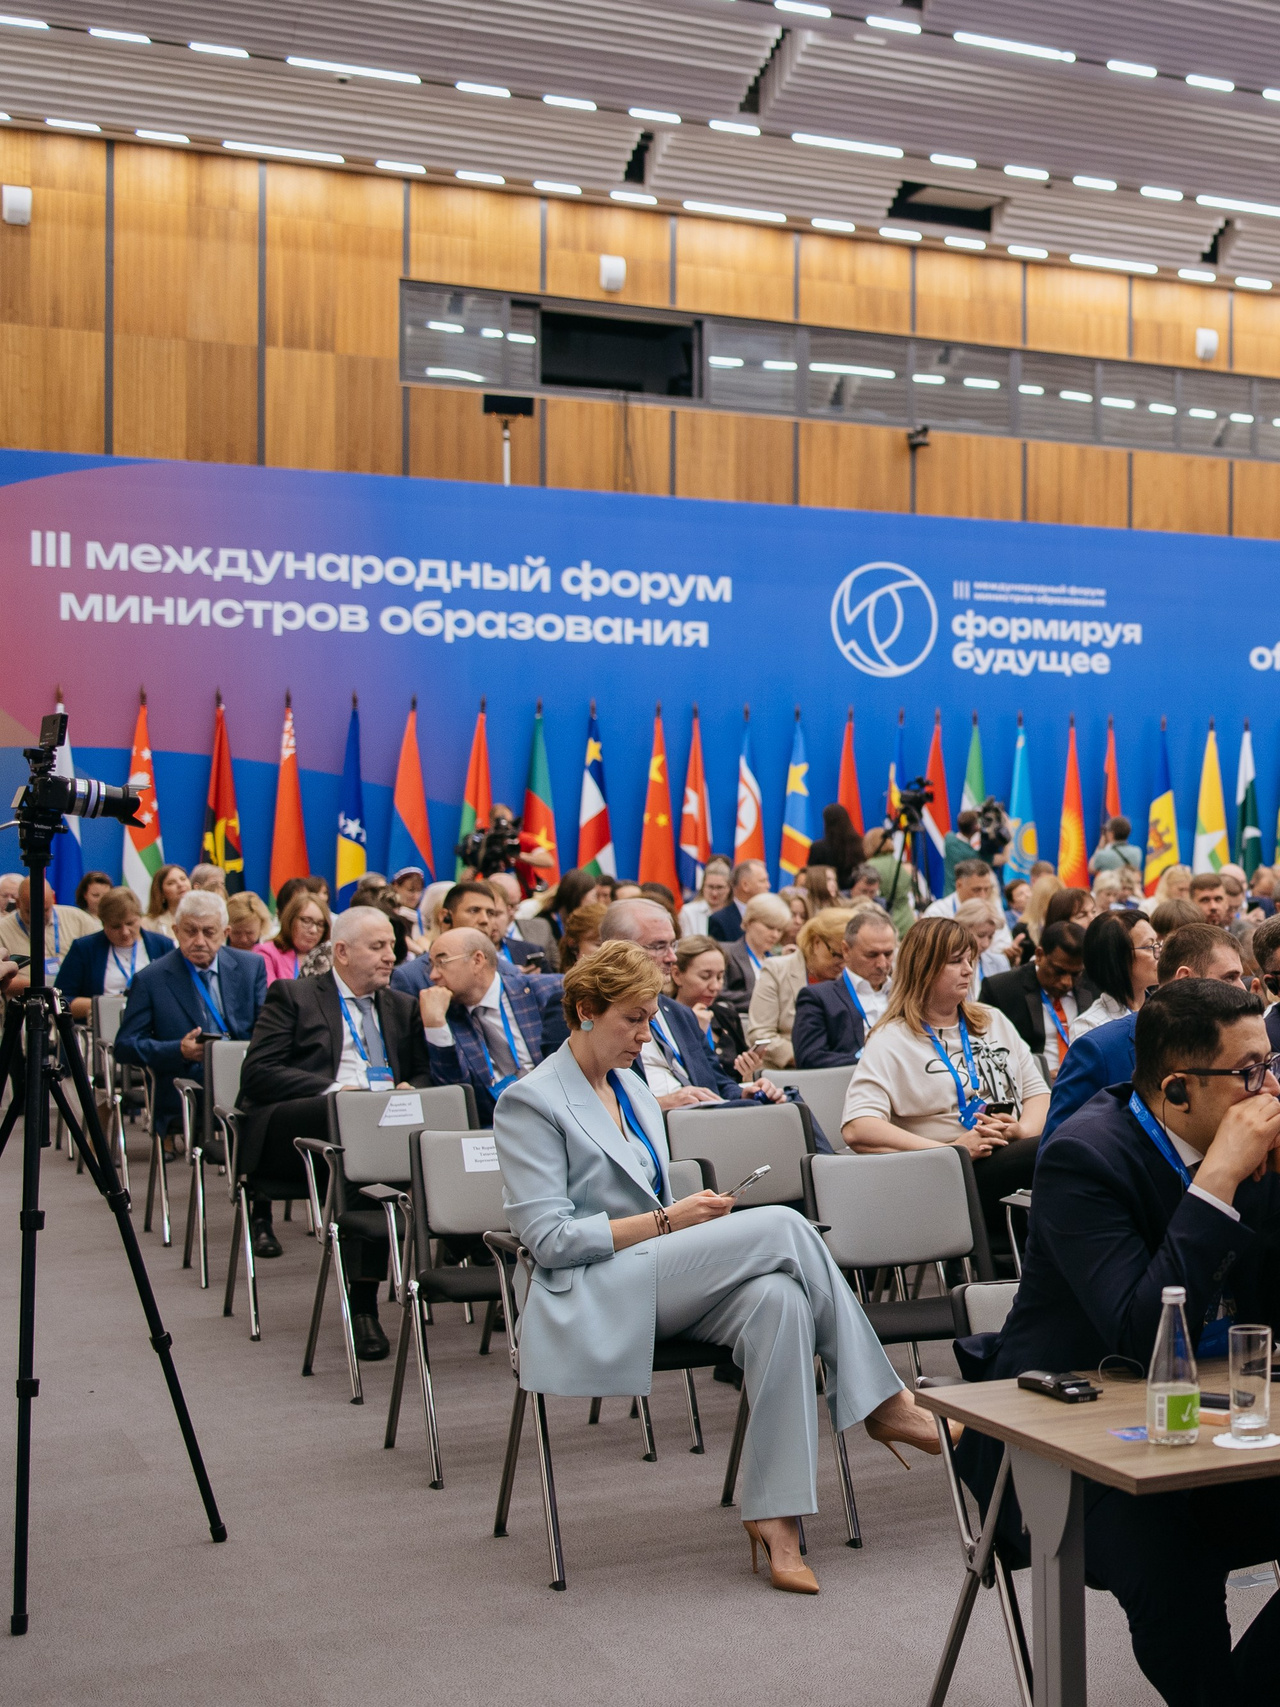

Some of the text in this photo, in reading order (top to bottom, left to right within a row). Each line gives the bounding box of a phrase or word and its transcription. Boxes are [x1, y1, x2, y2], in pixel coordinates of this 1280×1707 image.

[30, 530, 732, 607] III международный форум
[60, 592, 709, 647] министров образования
[951, 609, 1142, 649] формируя
[951, 640, 1111, 678] будущее
